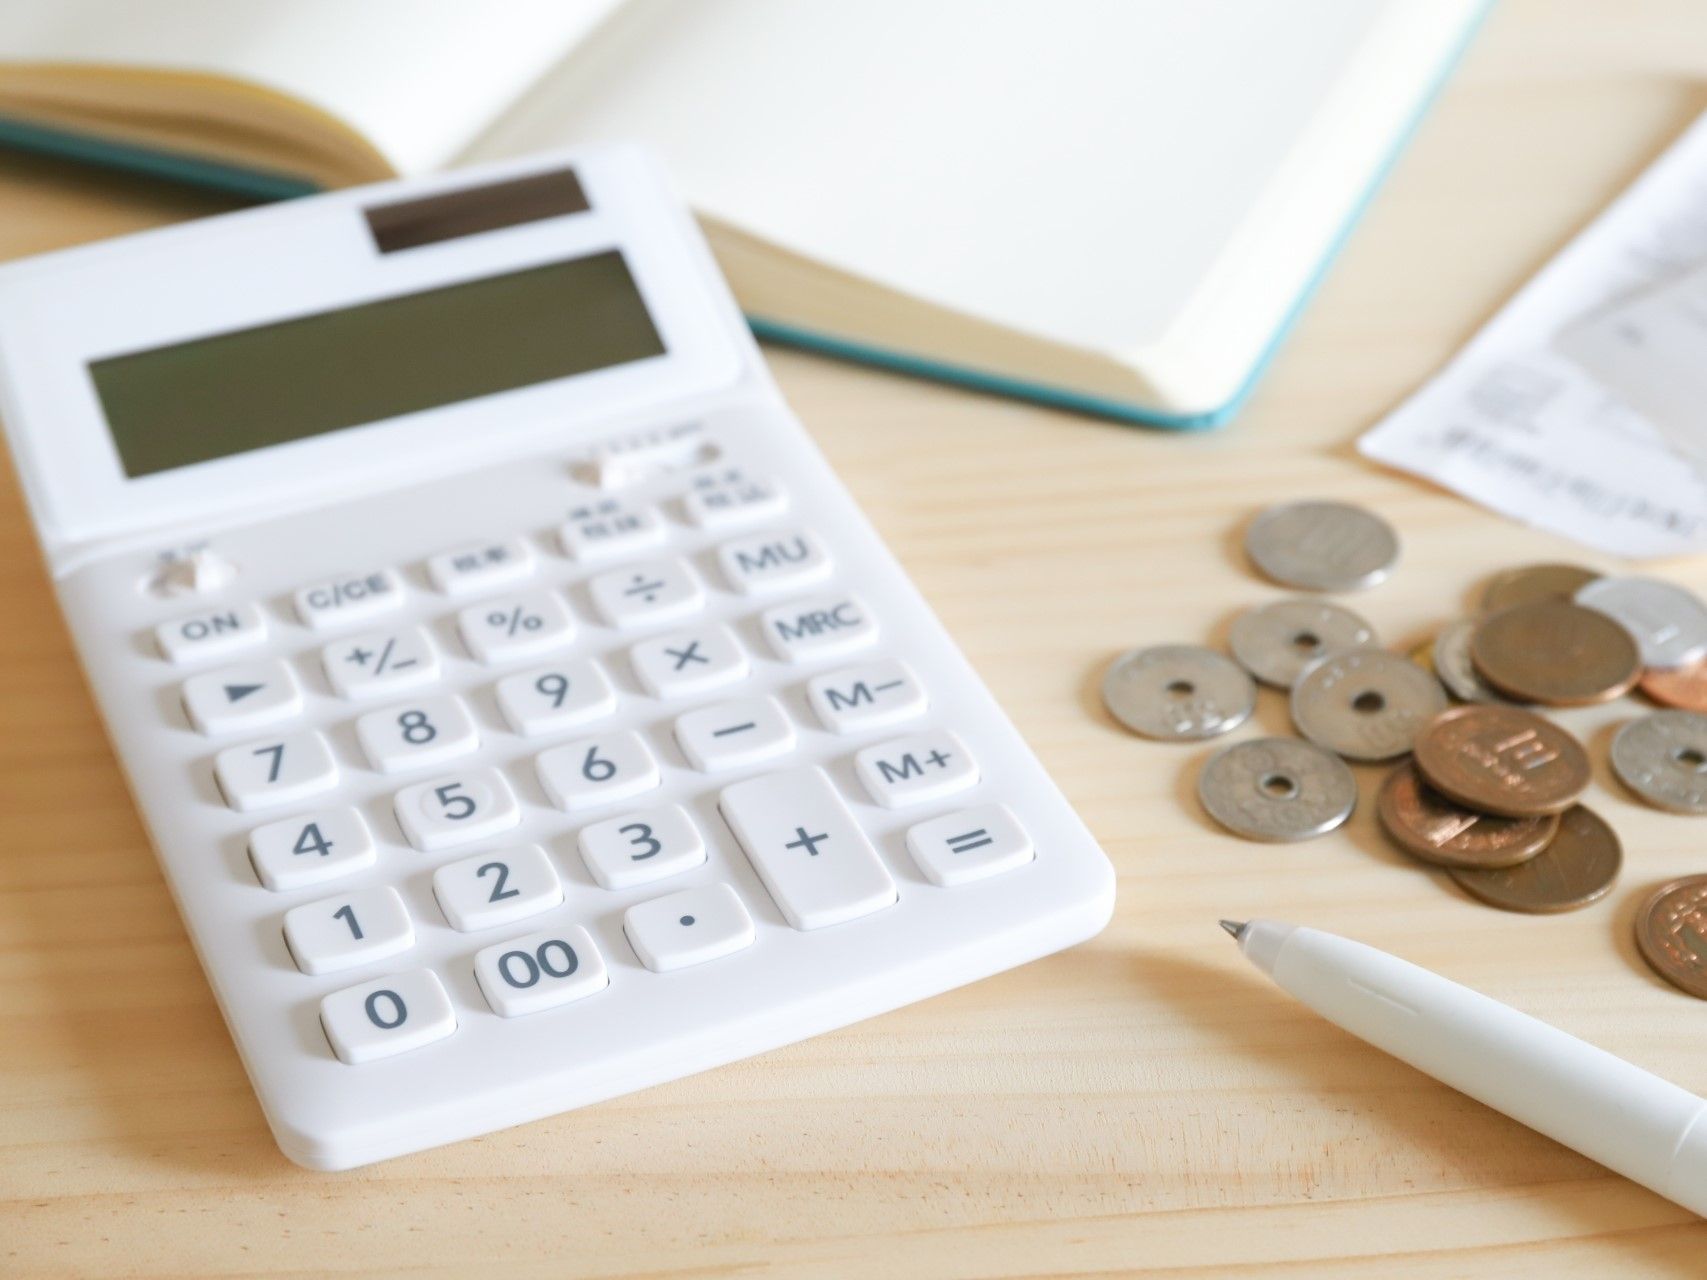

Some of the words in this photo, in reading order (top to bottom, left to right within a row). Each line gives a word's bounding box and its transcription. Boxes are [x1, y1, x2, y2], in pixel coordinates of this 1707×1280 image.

[735, 538, 809, 573] MU
[307, 573, 388, 609] C/CE
[181, 612, 240, 641] ON
[486, 606, 544, 637] %
[774, 603, 860, 641] MRC
[535, 673, 570, 709] 9
[825, 679, 903, 712] M-
[397, 710, 438, 746] 8
[253, 742, 286, 784] 7
[582, 746, 617, 784] 6
[875, 749, 951, 785] M+
[434, 782, 477, 822] 5
[292, 822, 334, 858] 4
[618, 823, 662, 863] 3
[784, 826, 829, 858] +
[945, 828, 994, 855] =
[477, 861, 521, 903] 2
[332, 904, 364, 942] 1
[497, 939, 579, 990] 00
[364, 989, 408, 1030] 0
